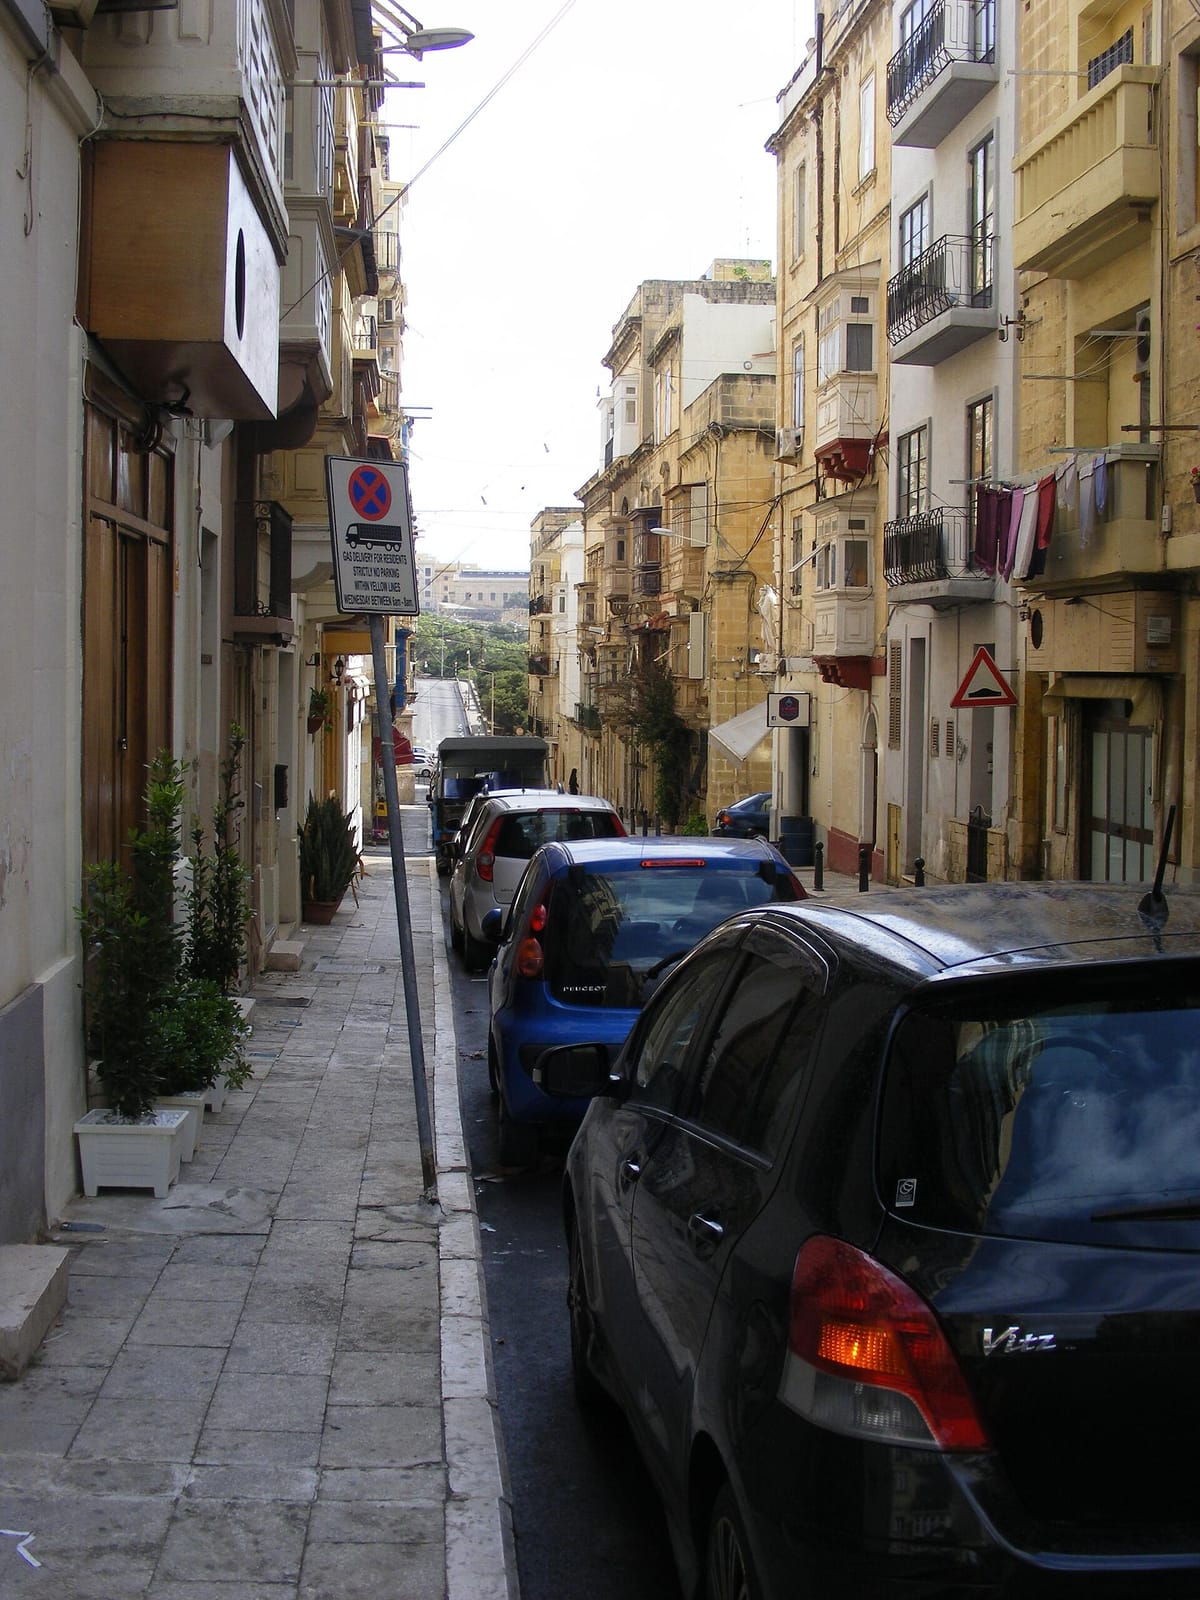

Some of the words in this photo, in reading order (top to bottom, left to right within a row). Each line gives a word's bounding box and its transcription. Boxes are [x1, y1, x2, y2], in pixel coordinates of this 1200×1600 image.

[343, 551, 352, 561] GAS
[353, 552, 373, 562] DELIVERY
[374, 553, 383, 563] FOR
[384, 554, 407, 565] RESIDENTS
[353, 566, 372, 577] STRICTLY
[374, 567, 380, 577] NO
[380, 568, 400, 578] PARKING
[354, 580, 369, 591] WITHIN
[370, 581, 387, 592] YELLOW
[388, 582, 401, 592] LINES
[344, 594, 370, 605] WEDNESDAY
[371, 595, 391, 606] BETWEEN
[983, 1326, 1057, 1357] Vitz
